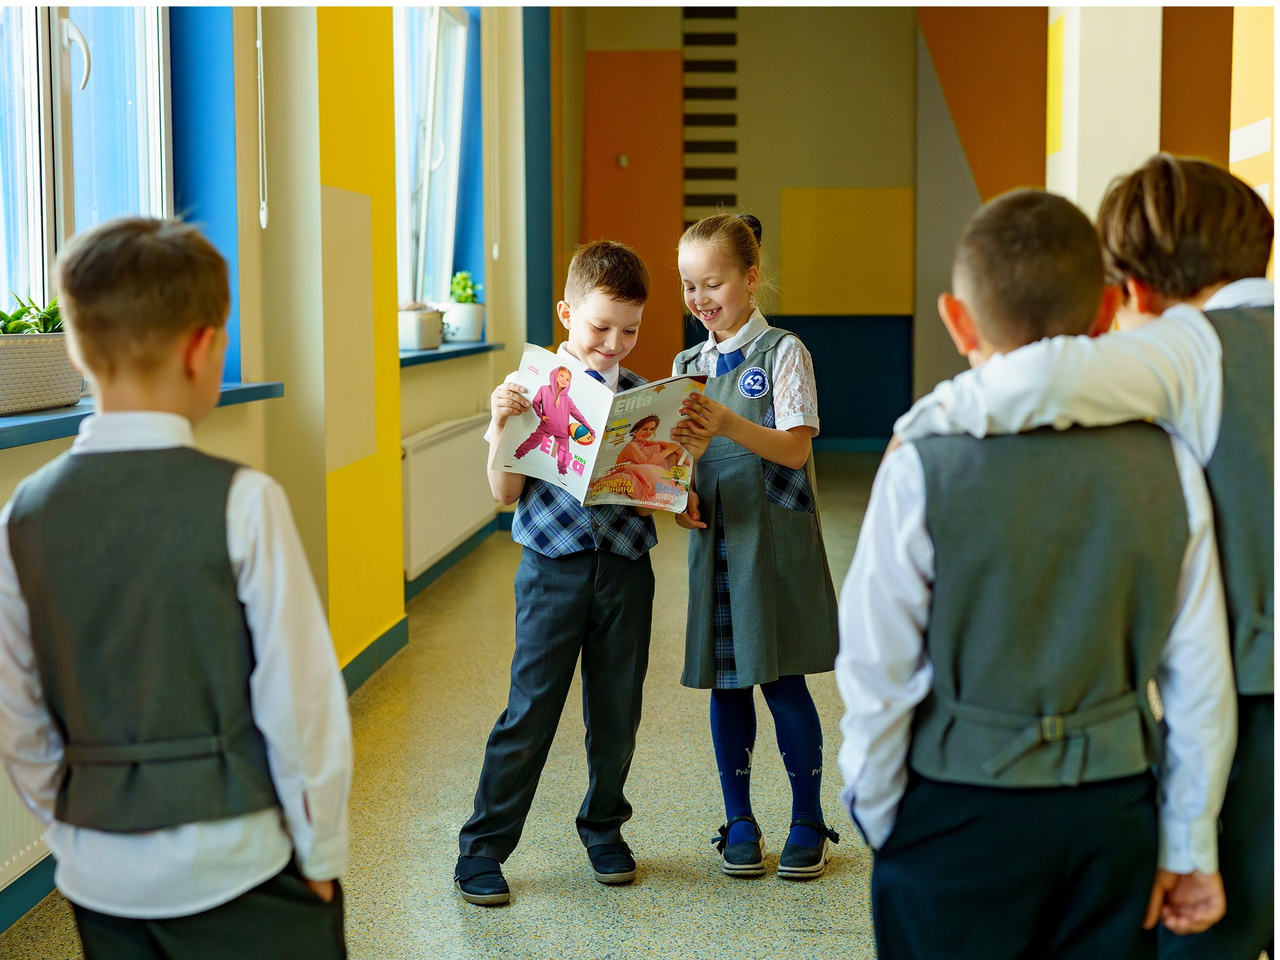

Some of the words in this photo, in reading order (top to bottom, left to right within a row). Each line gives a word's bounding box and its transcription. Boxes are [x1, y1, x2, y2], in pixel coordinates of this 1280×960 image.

[744, 375, 763, 390] 62
[613, 394, 653, 415] Elita
[539, 435, 586, 477] Elita
[573, 454, 587, 466] KIDS
